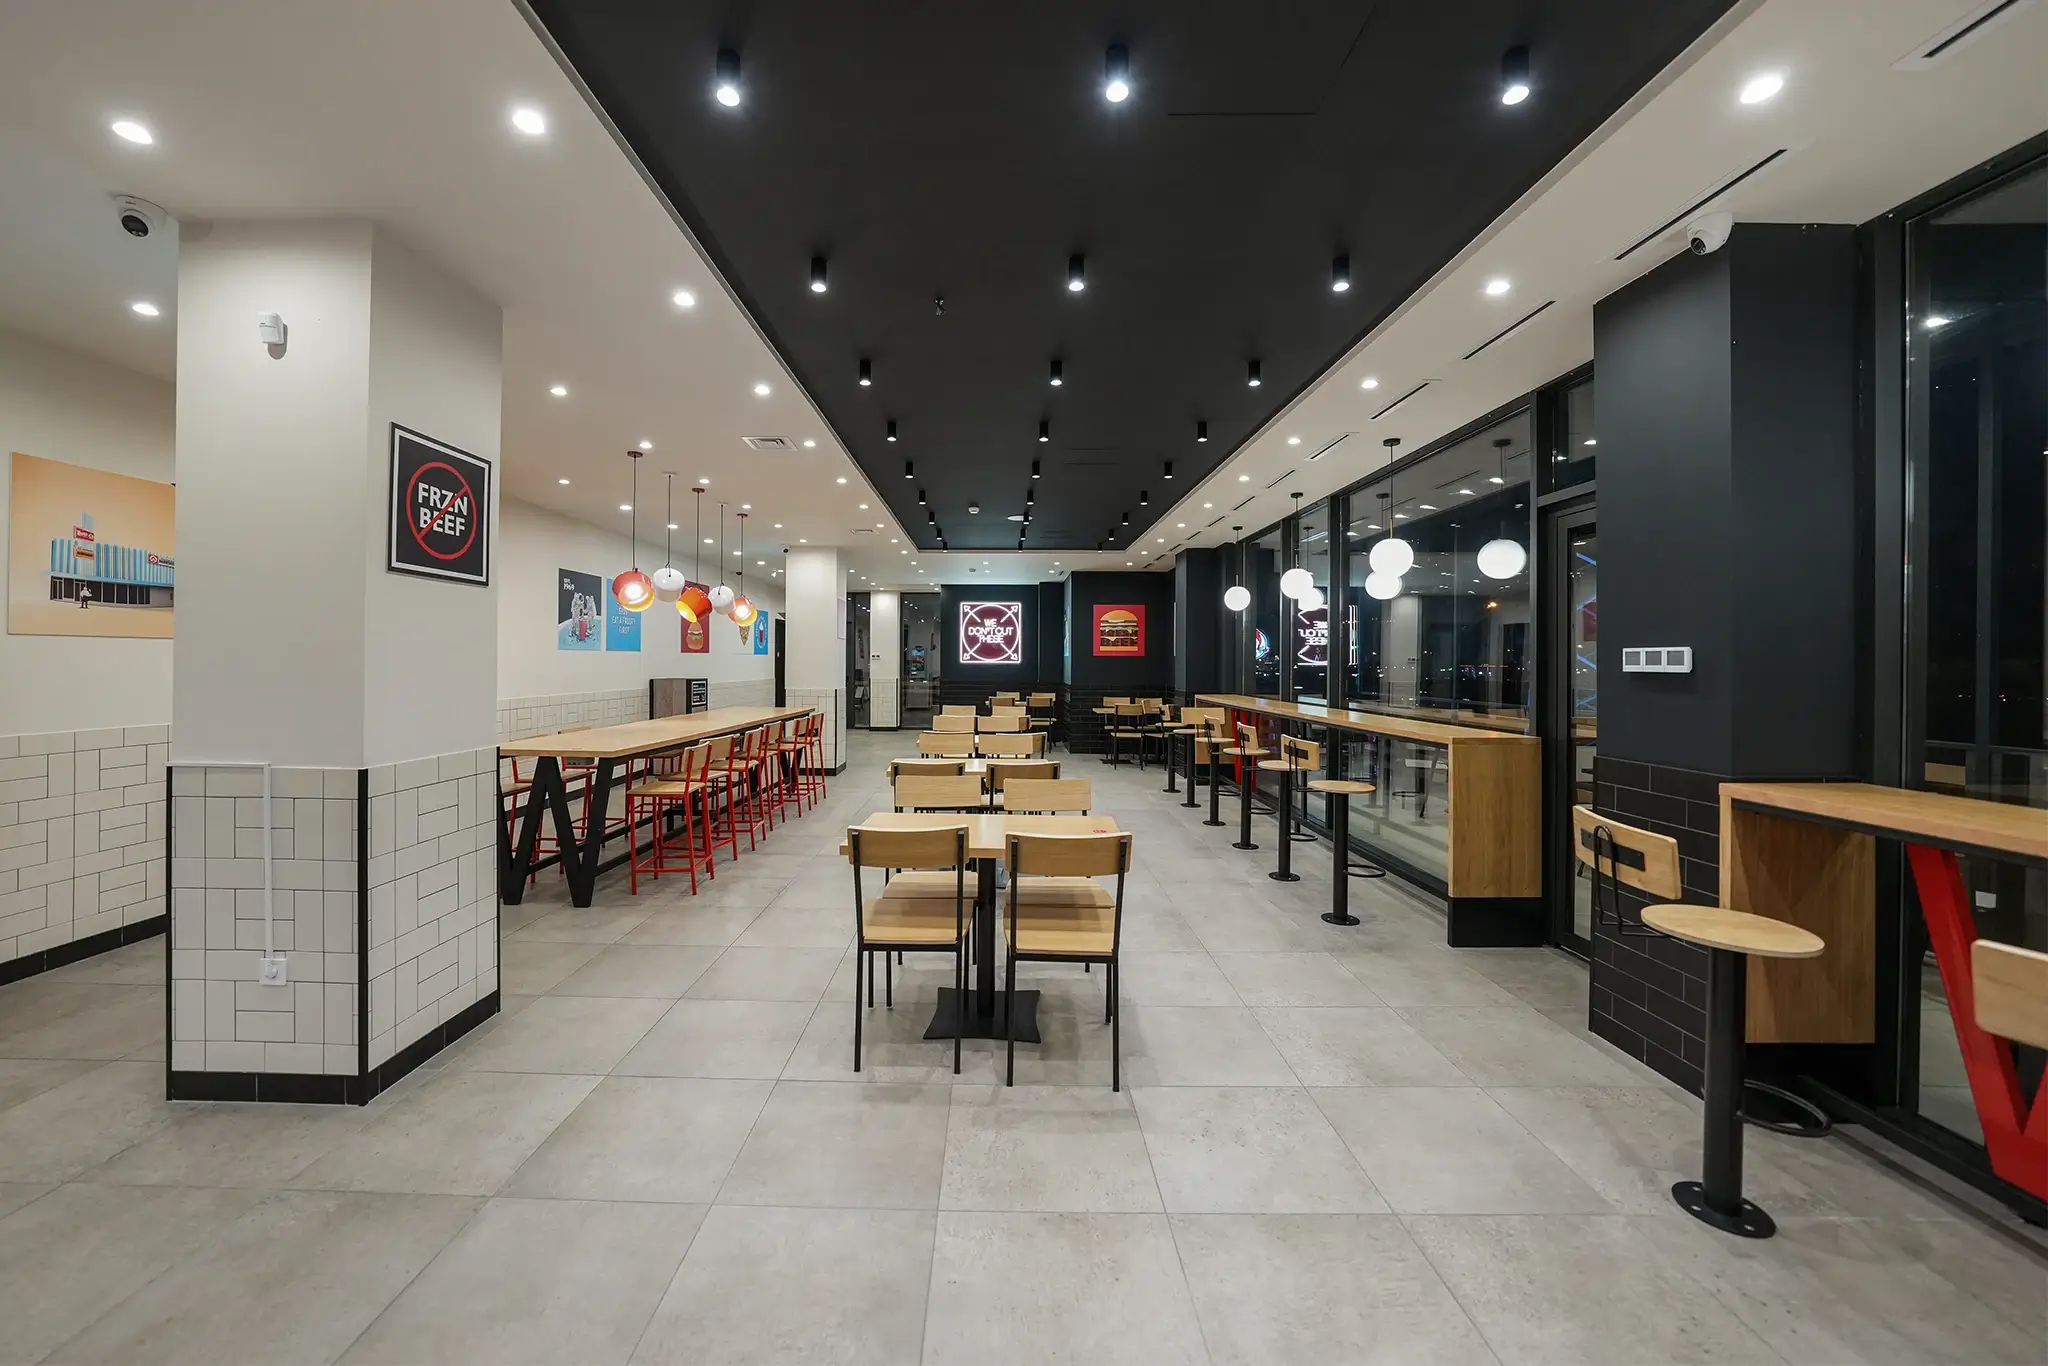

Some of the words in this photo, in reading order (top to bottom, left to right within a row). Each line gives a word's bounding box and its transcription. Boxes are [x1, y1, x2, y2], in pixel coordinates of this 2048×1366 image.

[418, 482, 467, 516] FRZN
[420, 507, 465, 537] BEEF
[984, 619, 997, 627] WE
[968, 627, 994, 635] DON'T
[995, 627, 1013, 635] CUT
[977, 635, 1004, 643] THESE
[1101, 638, 1138, 646] BEEF
